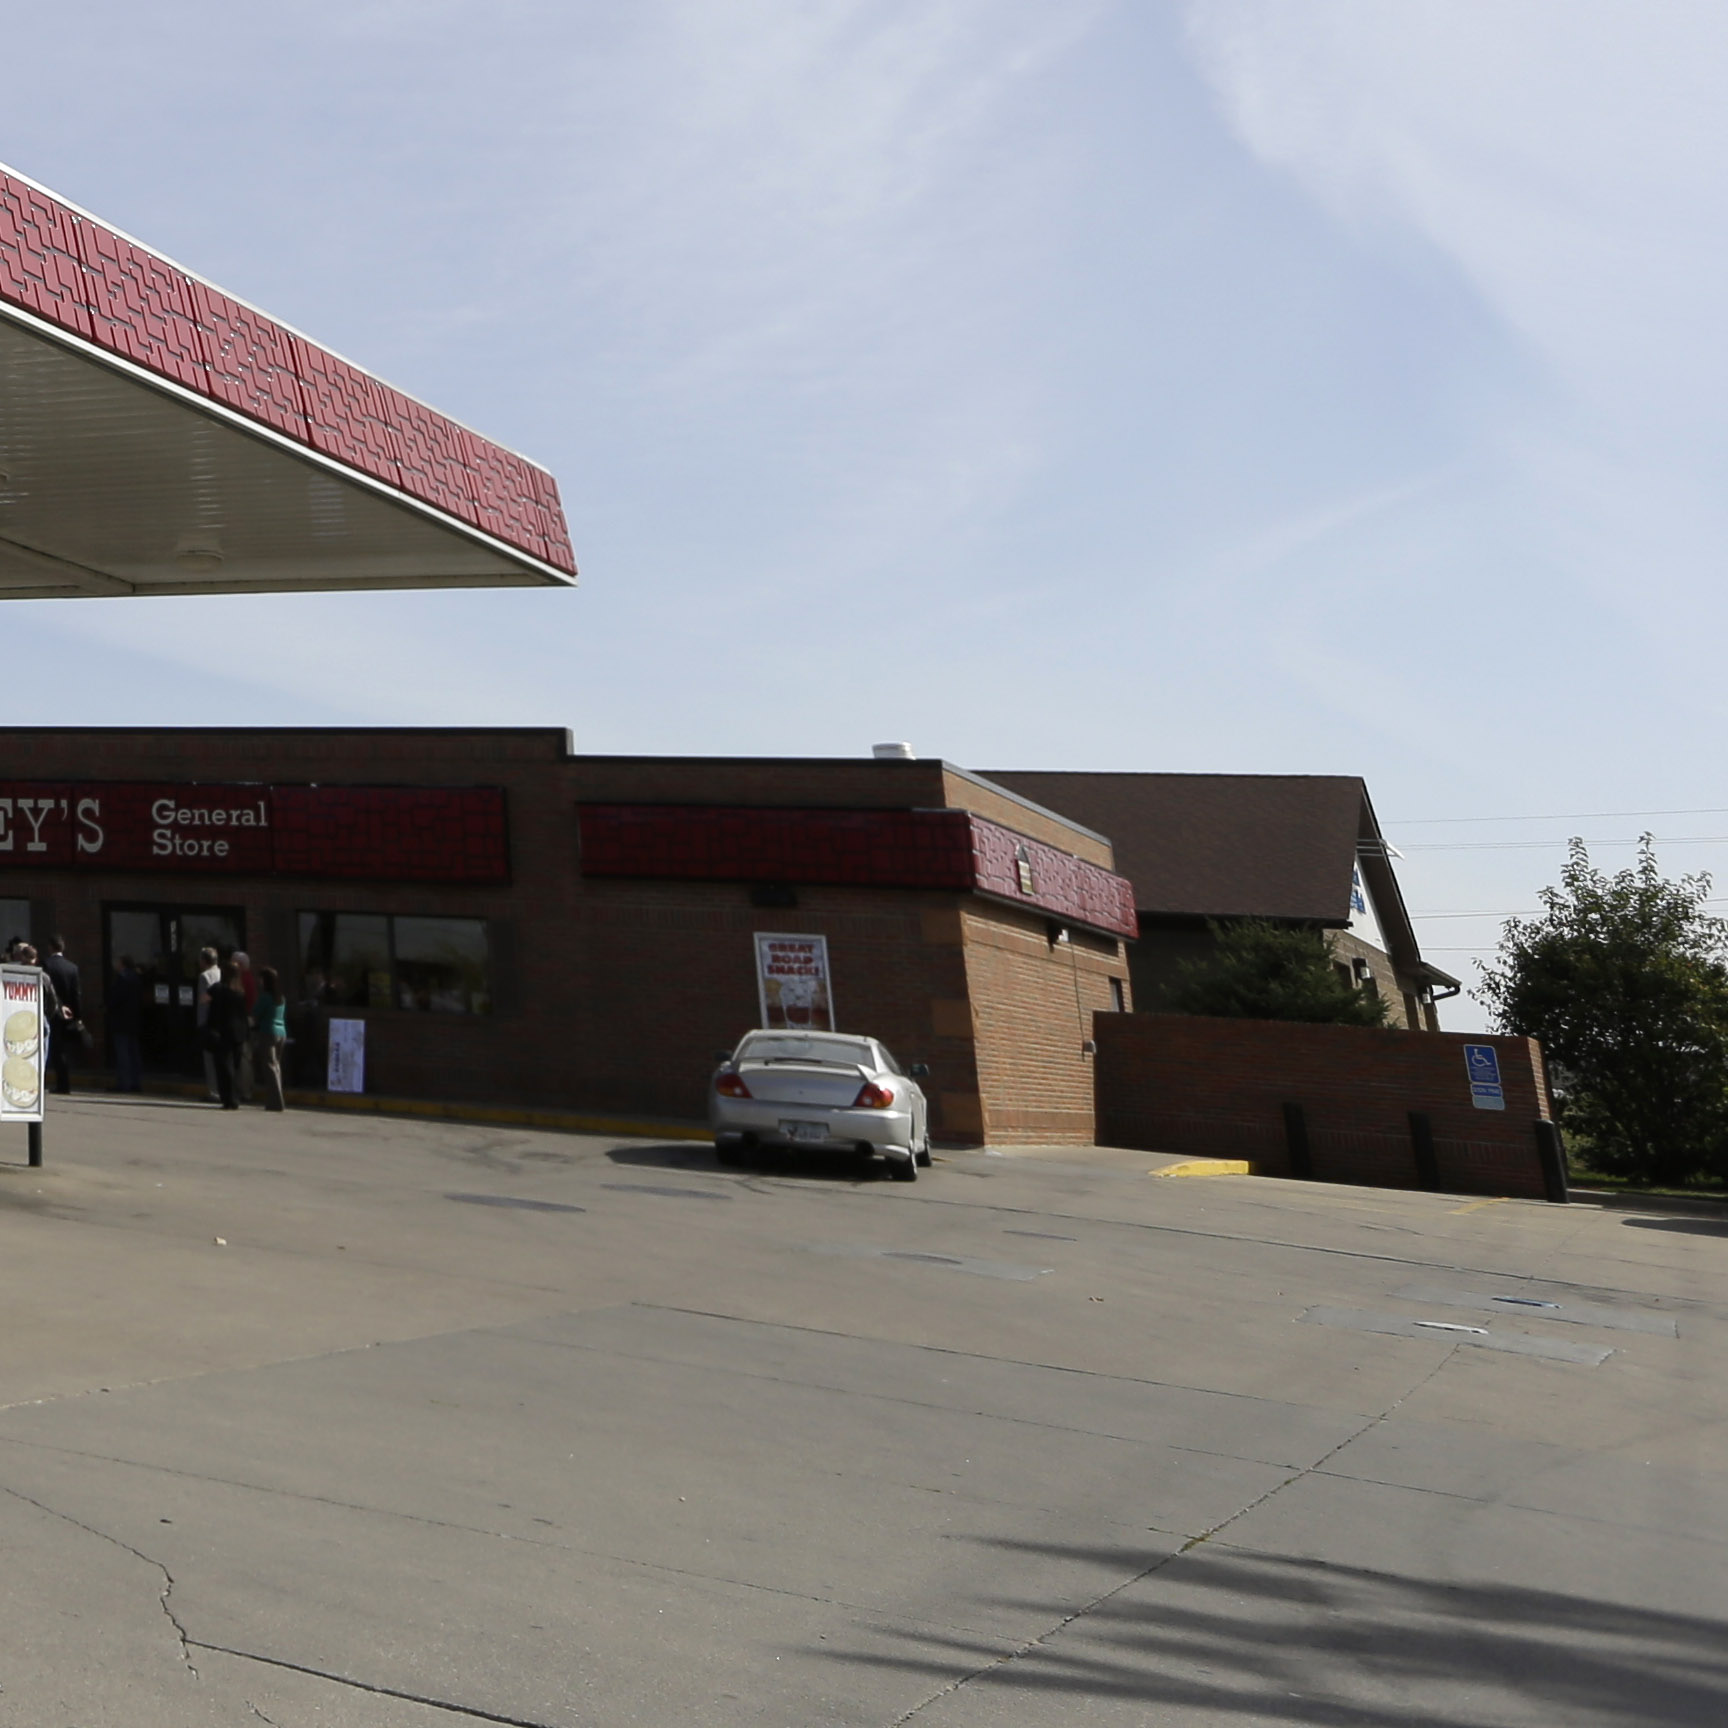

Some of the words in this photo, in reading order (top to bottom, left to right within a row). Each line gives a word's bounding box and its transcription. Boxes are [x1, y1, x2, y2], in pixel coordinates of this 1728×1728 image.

[151, 798, 269, 828] General
[152, 828, 230, 857] Store
[768, 943, 814, 953] GREAT
[771, 954, 813, 964] ROAD
[767, 964, 820, 976] SNACK!
[3, 981, 38, 1003] YUMMY!
